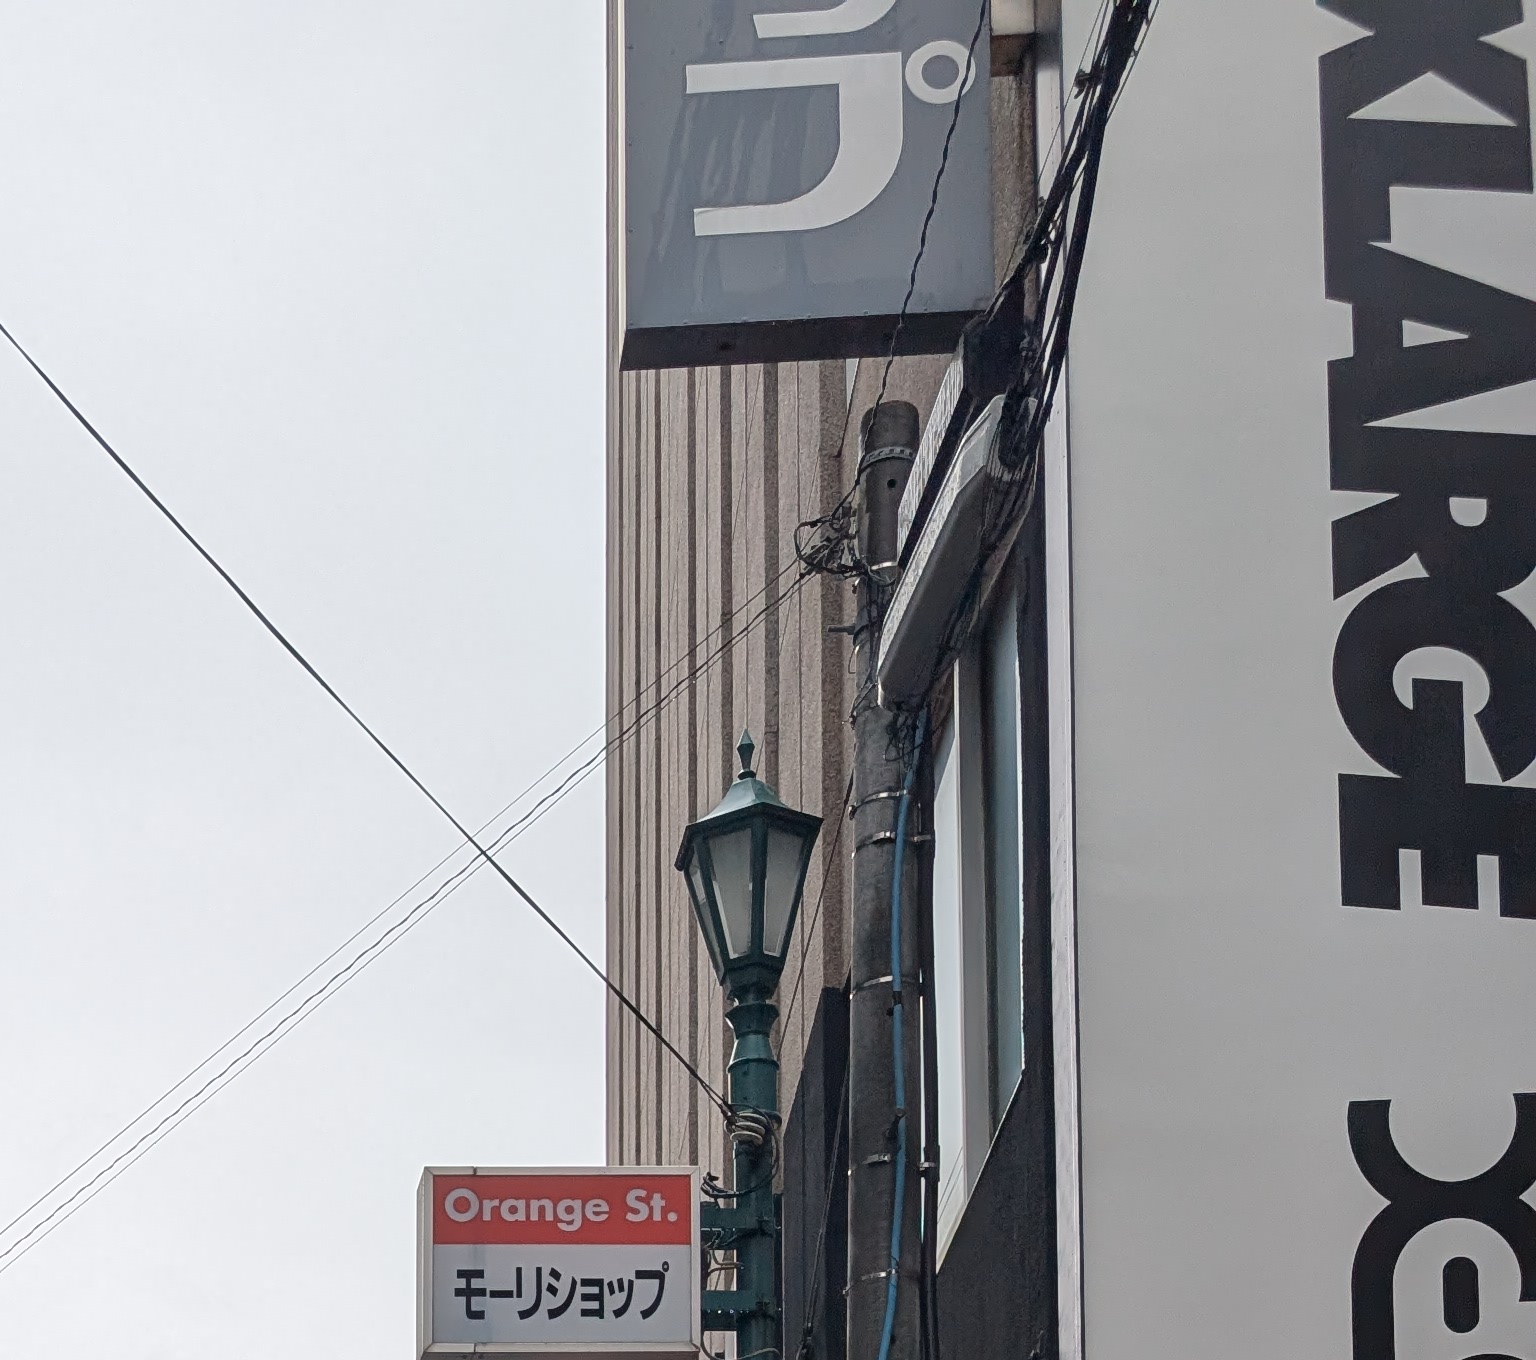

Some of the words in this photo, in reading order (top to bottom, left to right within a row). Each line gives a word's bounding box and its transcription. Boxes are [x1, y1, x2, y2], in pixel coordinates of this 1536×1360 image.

[443, 1189, 609, 1231] Orange
[625, 1189, 679, 1222] St.
[454, 1261, 670, 1321] モーリショップ
